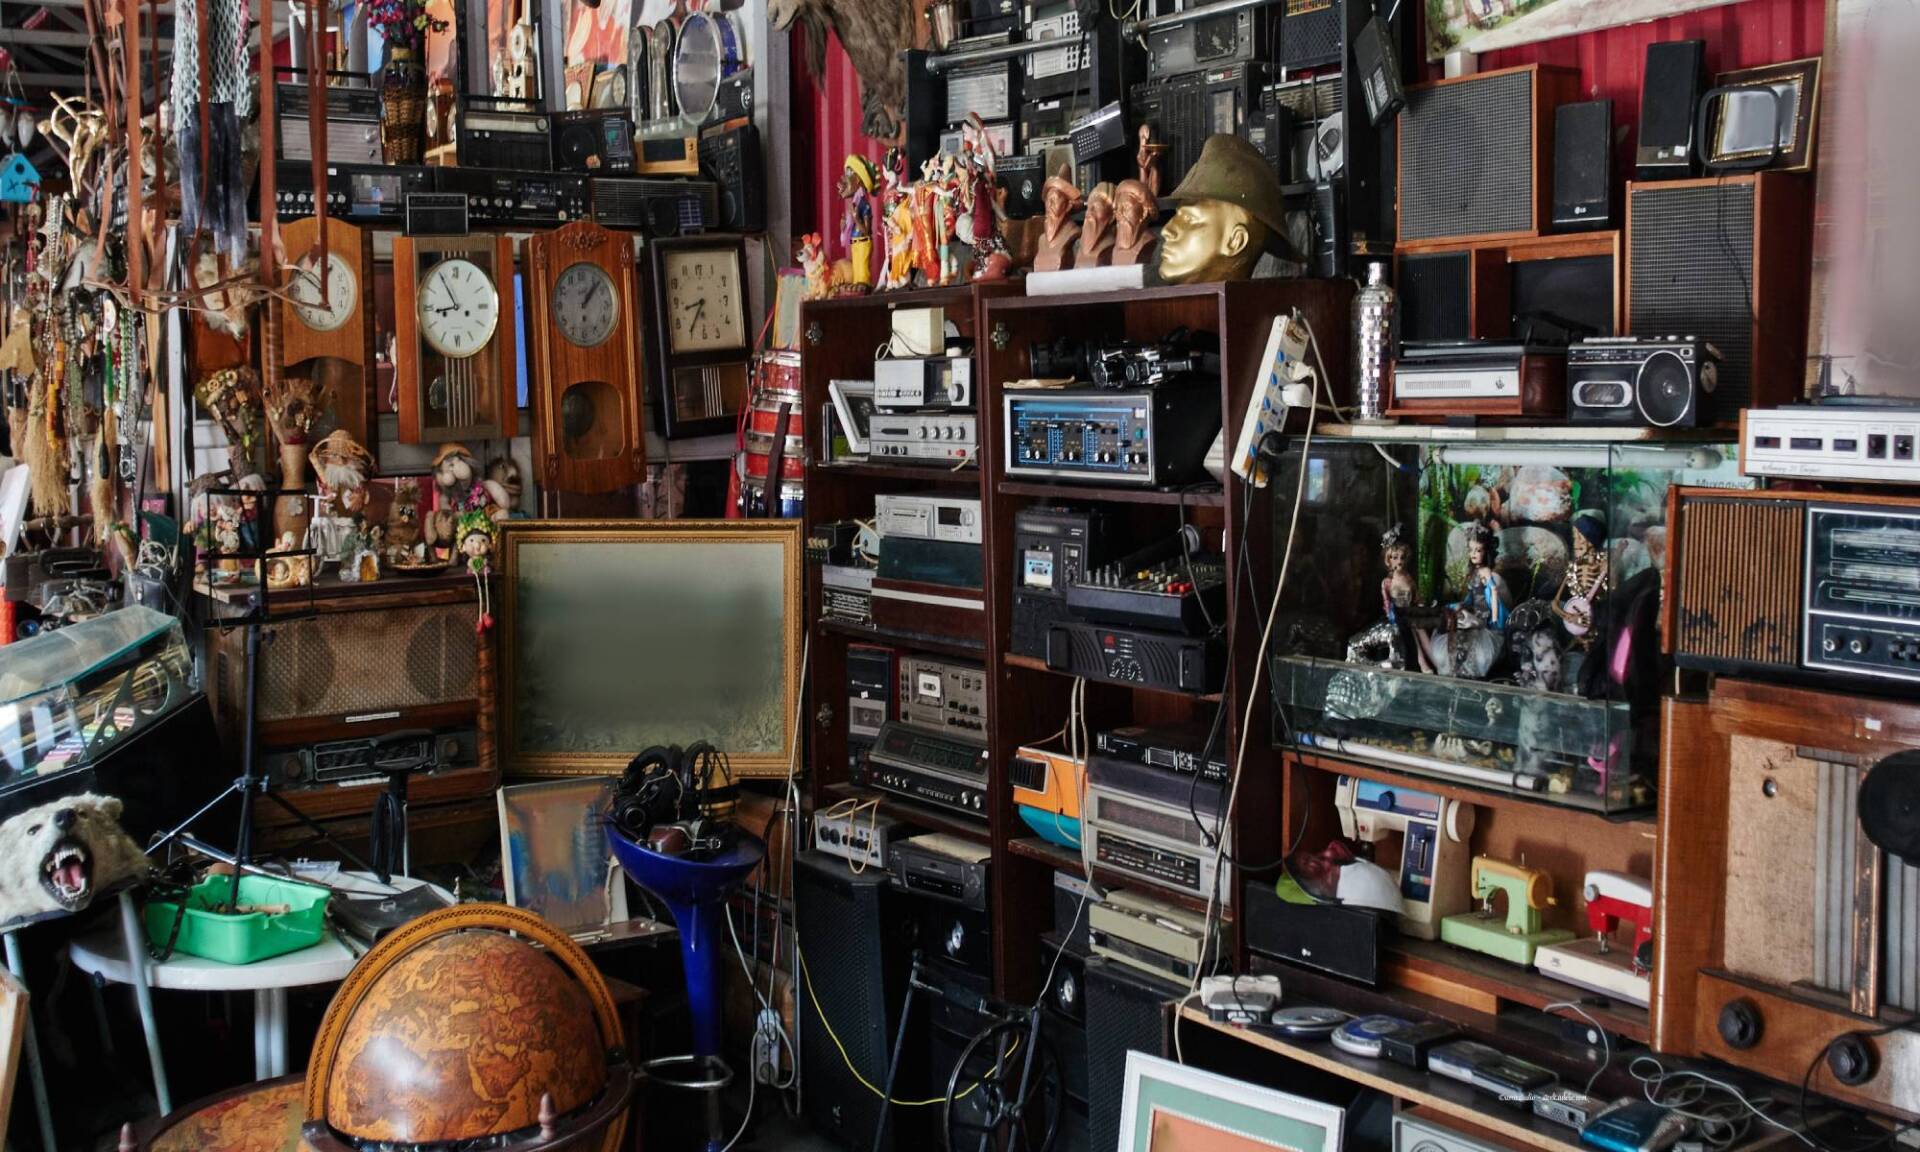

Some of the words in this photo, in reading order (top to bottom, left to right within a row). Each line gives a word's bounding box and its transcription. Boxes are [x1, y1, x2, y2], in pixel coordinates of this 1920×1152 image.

[682, 265, 688, 276] 11
[723, 295, 729, 307] 3
[702, 325, 708, 340] 6
